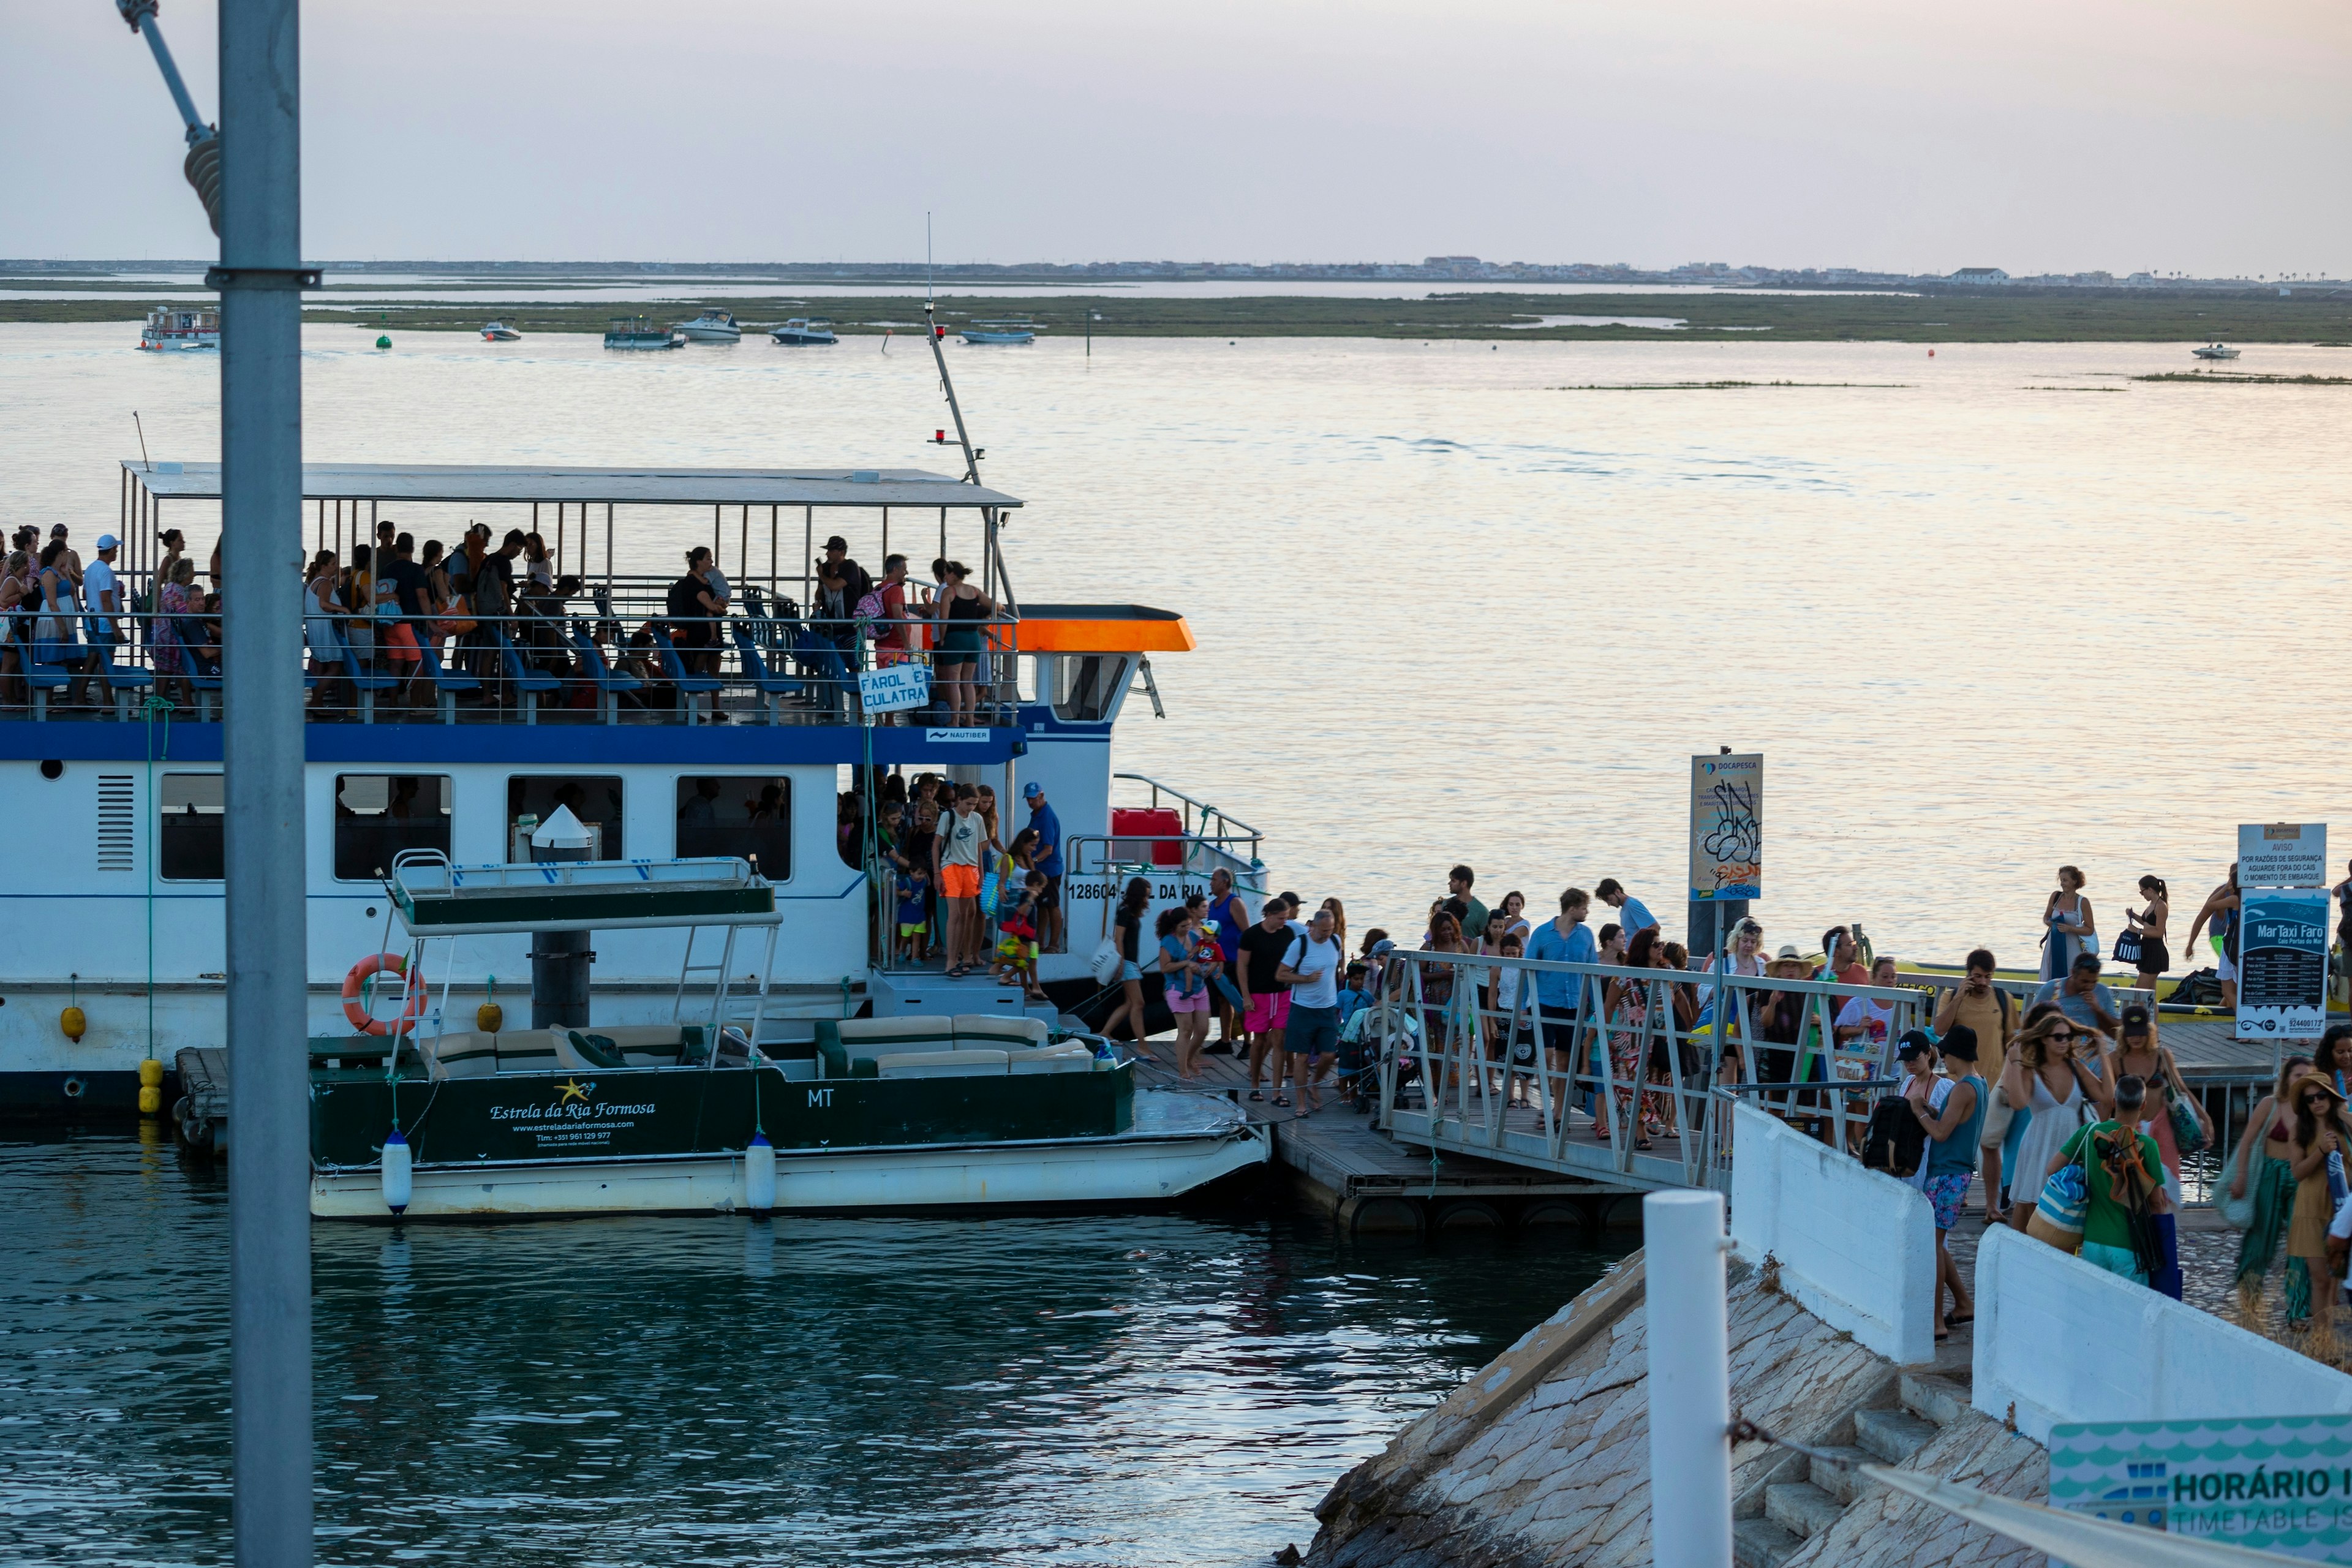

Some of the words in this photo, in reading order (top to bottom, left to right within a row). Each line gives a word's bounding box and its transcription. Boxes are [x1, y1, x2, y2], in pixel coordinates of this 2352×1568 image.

[861, 674, 905, 692] FAROL
[914, 671, 924, 683] E
[864, 687, 925, 707] CULATRA
[2272, 843, 2293, 851] AVISO
[2288, 854, 2323, 863] SEGURANÇA
[1068, 884, 1117, 899] 128604
[1159, 884, 1177, 899] DA
[1182, 884, 1203, 899] RIA
[2301, 924, 2323, 938] Faro
[808, 1088, 834, 1107] MT
[490, 1103, 541, 1120] Estrela
[545, 1102, 563, 1118] da
[565, 1103, 592, 1120] Ria
[594, 1102, 656, 1118] Formosa
[513, 1121, 634, 1132] www.estreladariaformosa.com
[2174, 1464, 2331, 1502] HORÁRIO
[2173, 1507, 2318, 1532] TIMETABLE
